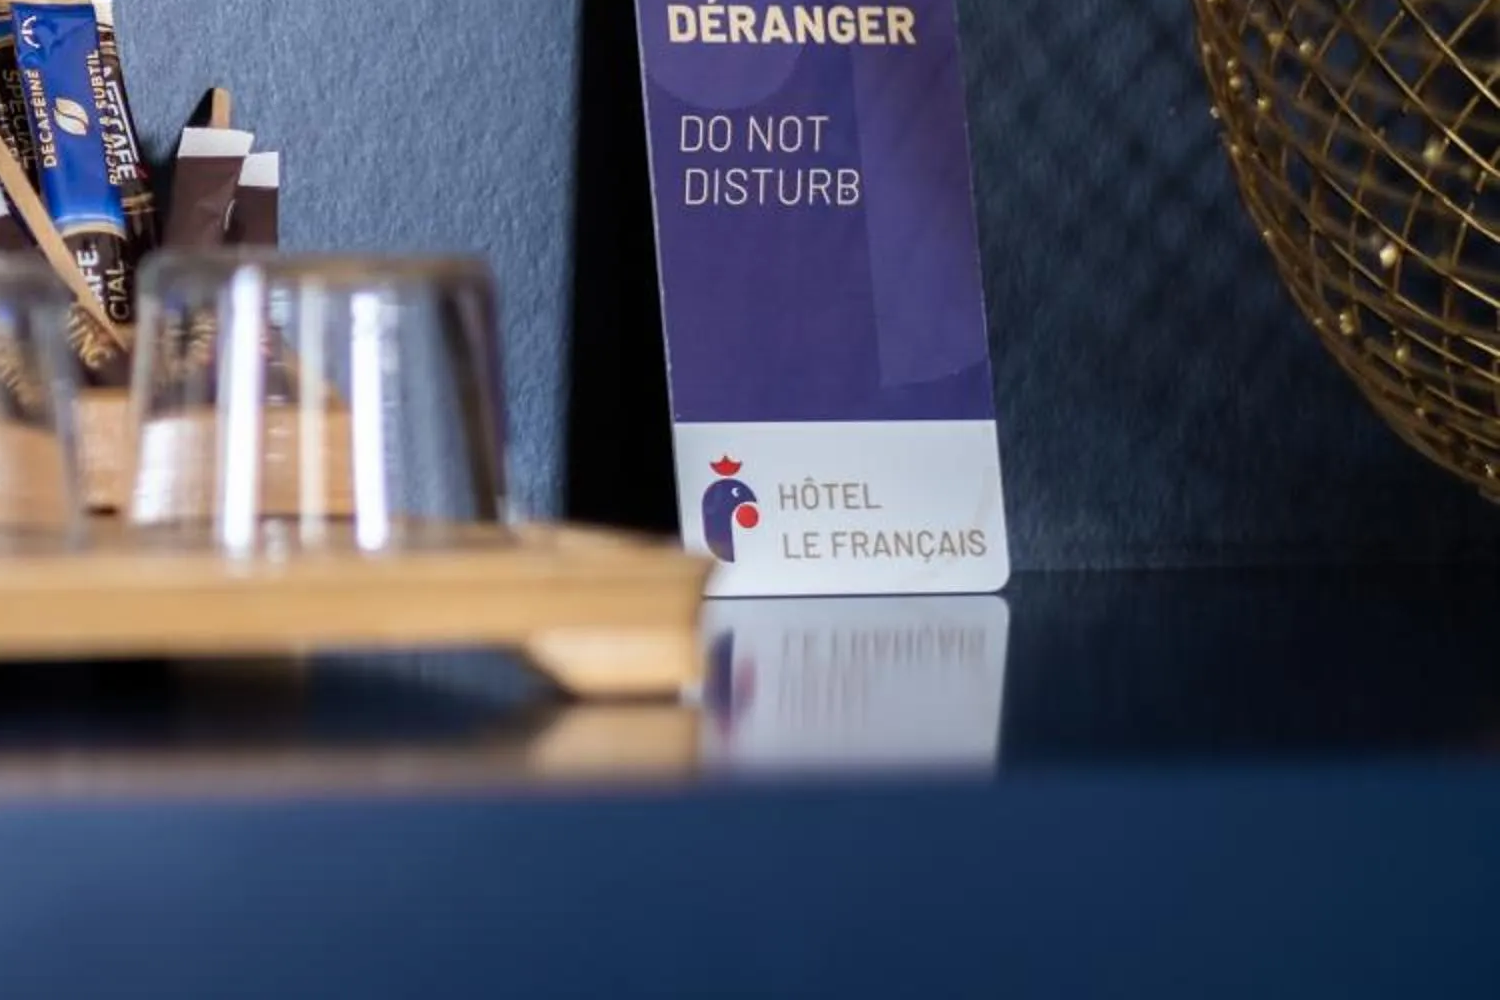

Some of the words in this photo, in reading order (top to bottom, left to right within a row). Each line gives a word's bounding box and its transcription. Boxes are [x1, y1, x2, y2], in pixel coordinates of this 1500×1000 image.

[85, 49, 109, 110] SUBTIL
[679, 114, 732, 153] DO
[746, 114, 830, 153] NOT
[683, 167, 861, 206] DISTURB
[104, 259, 131, 321] CIAL
[778, 477, 882, 511] HÔTEL
[782, 532, 822, 560] LE
[831, 529, 988, 564] FRANÇAIS
